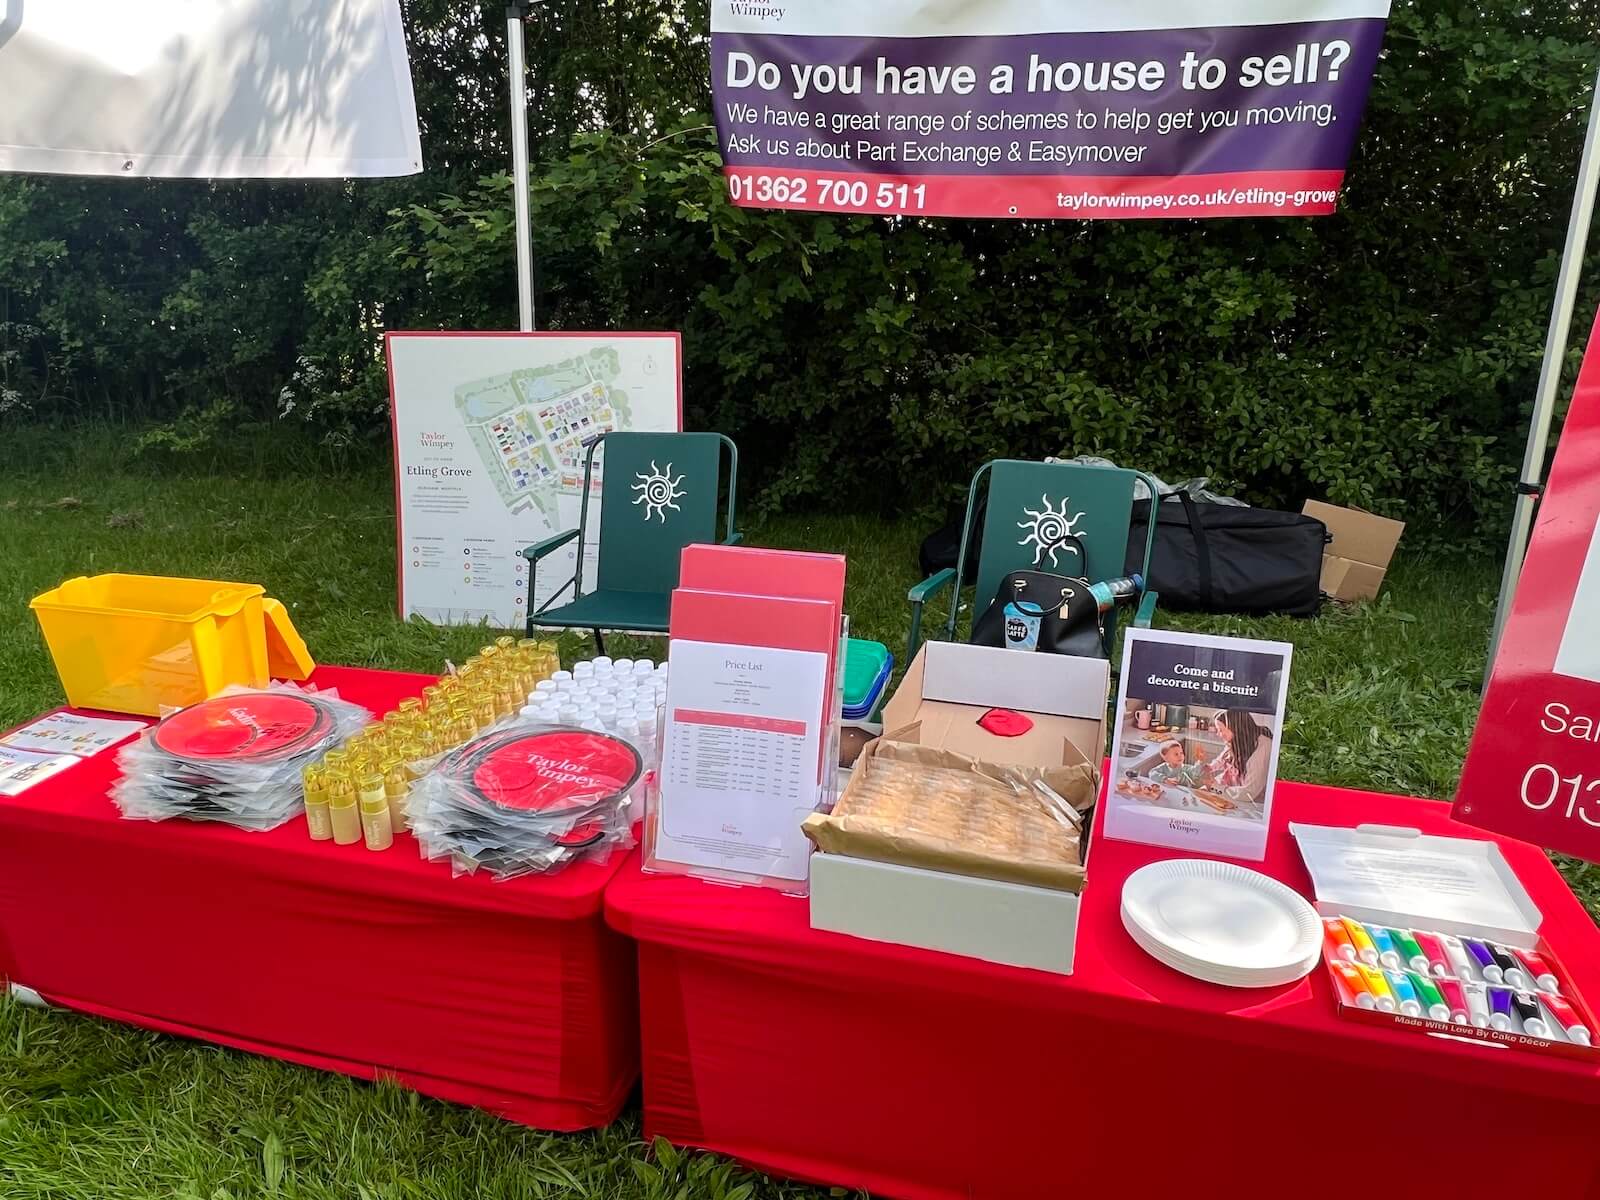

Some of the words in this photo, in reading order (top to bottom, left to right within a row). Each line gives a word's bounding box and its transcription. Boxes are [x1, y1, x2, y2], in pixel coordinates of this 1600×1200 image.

[730, 3, 785, 21] Wimpey
[727, 52, 781, 90] Do
[792, 63, 862, 100] you
[876, 57, 976, 95] have
[989, 65, 1013, 94] a
[1028, 54, 1165, 93] house
[1180, 51, 1227, 91] to
[1238, 40, 1351, 88] sell?
[727, 103, 758, 124] We
[764, 105, 809, 128] have
[815, 111, 826, 128] a
[832, 111, 880, 134] great
[887, 113, 944, 135] range
[951, 110, 972, 131] of
[977, 110, 1068, 131] schemes
[1077, 108, 1097, 130] to
[1104, 107, 1150, 134] help
[1158, 108, 1194, 134] get
[1199, 109, 1239, 133] you
[1246, 100, 1337, 127] moving.
[727, 134, 760, 153] Ask
[767, 139, 789, 155] us
[795, 138, 851, 160] about
[857, 140, 896, 161] Part
[903, 142, 1001, 166] Exchange
[1008, 142, 1021, 161] &
[1029, 141, 1147, 167] Easymover
[730, 175, 808, 204] 01362
[816, 180, 867, 206] 700
[876, 183, 926, 209] 511
[1057, 188, 1336, 209] taylorwimpey.co.uk/etling-grove
[420, 432, 446, 441] Taylor
[420, 440, 454, 449] Wimpey
[407, 466, 438, 478] Etling
[441, 467, 472, 476] Grove
[1008, 630, 1025, 638] LATTE
[725, 660, 747, 669] Price
[748, 662, 762, 671] List
[1174, 664, 1208, 677] Come
[1211, 670, 1234, 680] and
[1147, 675, 1200, 690] decorate
[1202, 683, 1210, 691] a
[1212, 682, 1258, 696] biscuit!
[527, 753, 589, 773] Taylor
[1395, 1016, 1423, 1027] Made
[1425, 1021, 1448, 1031] With
[1450, 1025, 1473, 1035] Love
[1476, 1029, 1490, 1038] By
[1492, 1032, 1517, 1042] Cake
